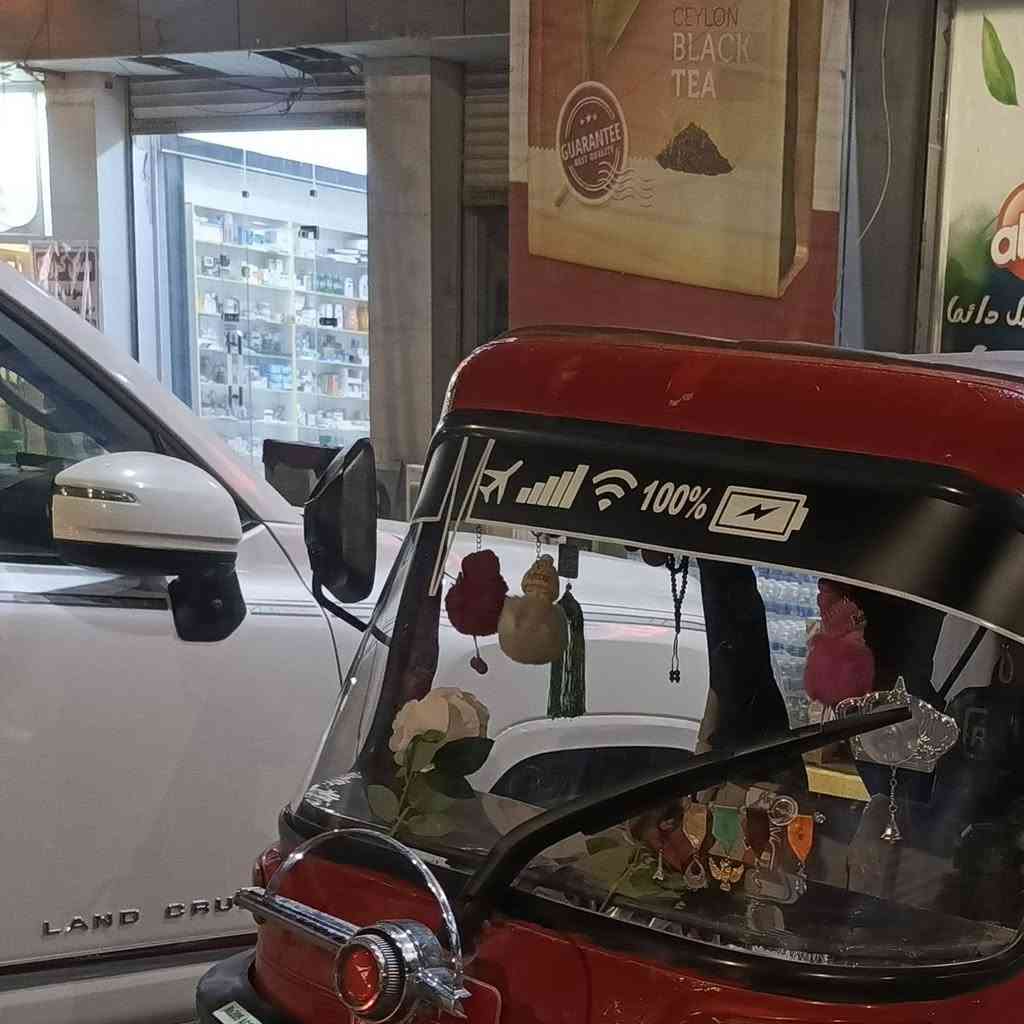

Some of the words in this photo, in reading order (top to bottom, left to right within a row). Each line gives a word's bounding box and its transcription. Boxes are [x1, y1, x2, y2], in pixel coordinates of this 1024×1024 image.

[672, 7, 738, 27] CEYLON
[672, 32, 752, 64] BLACK
[672, 69, 717, 98] TEA
[561, 122, 621, 160] GUARANTEE
[640, 480, 712, 520] 100%
[42, 908, 140, 937] LAND
[164, 896, 240, 919] CRU
